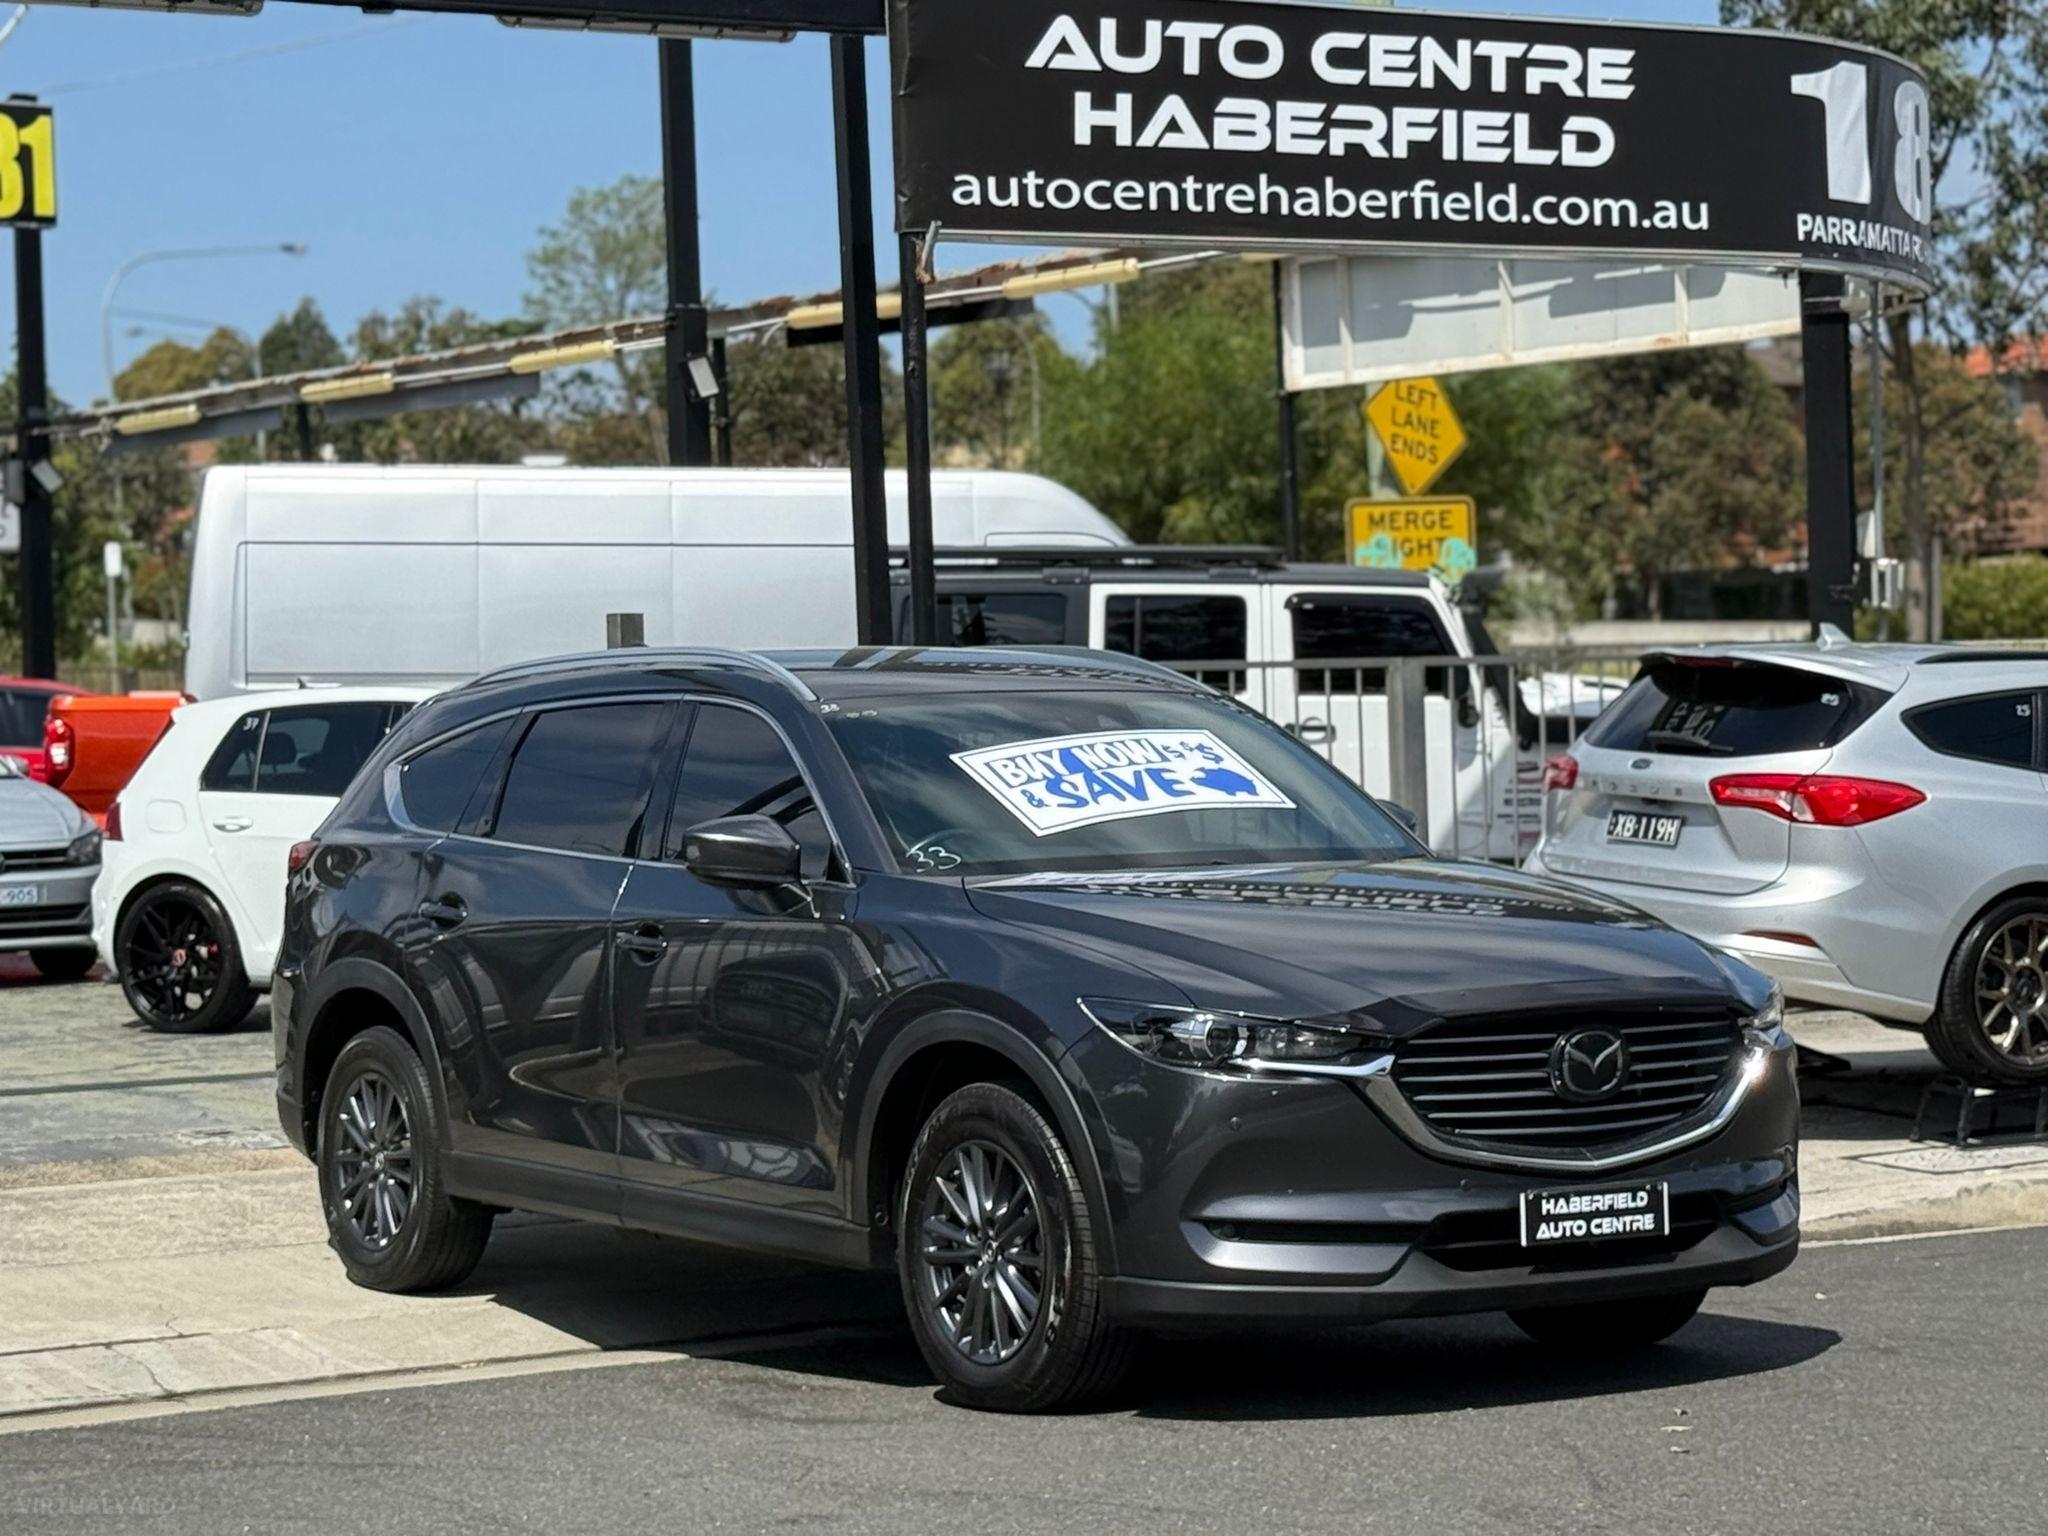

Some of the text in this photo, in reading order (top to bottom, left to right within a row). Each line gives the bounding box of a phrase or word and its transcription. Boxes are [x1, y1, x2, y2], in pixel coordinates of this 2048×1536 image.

[1024, 14, 1636, 100] AUTO CENTRE
[1073, 90, 1617, 168] HABERFIELD
[951, 169, 1710, 232] autocentrehaberfield.com.au
[1796, 213, 1911, 257] PARRAMATTA
[1394, 380, 1438, 411] LEFT
[1390, 406, 1440, 438] LANE
[1389, 432, 1440, 465] ENDS
[1367, 510, 1453, 532] MERGE
[1374, 537, 1450, 559] IGHT
[989, 748, 1069, 787] BUY
[1071, 738, 1163, 771] NOW
[1020, 767, 1196, 809] & SAVE
[908, 845, 962, 873] 33
[1541, 1190, 1649, 1216] HABERFIELD
[1535, 1213, 1656, 1240] AUTO CENTRE
